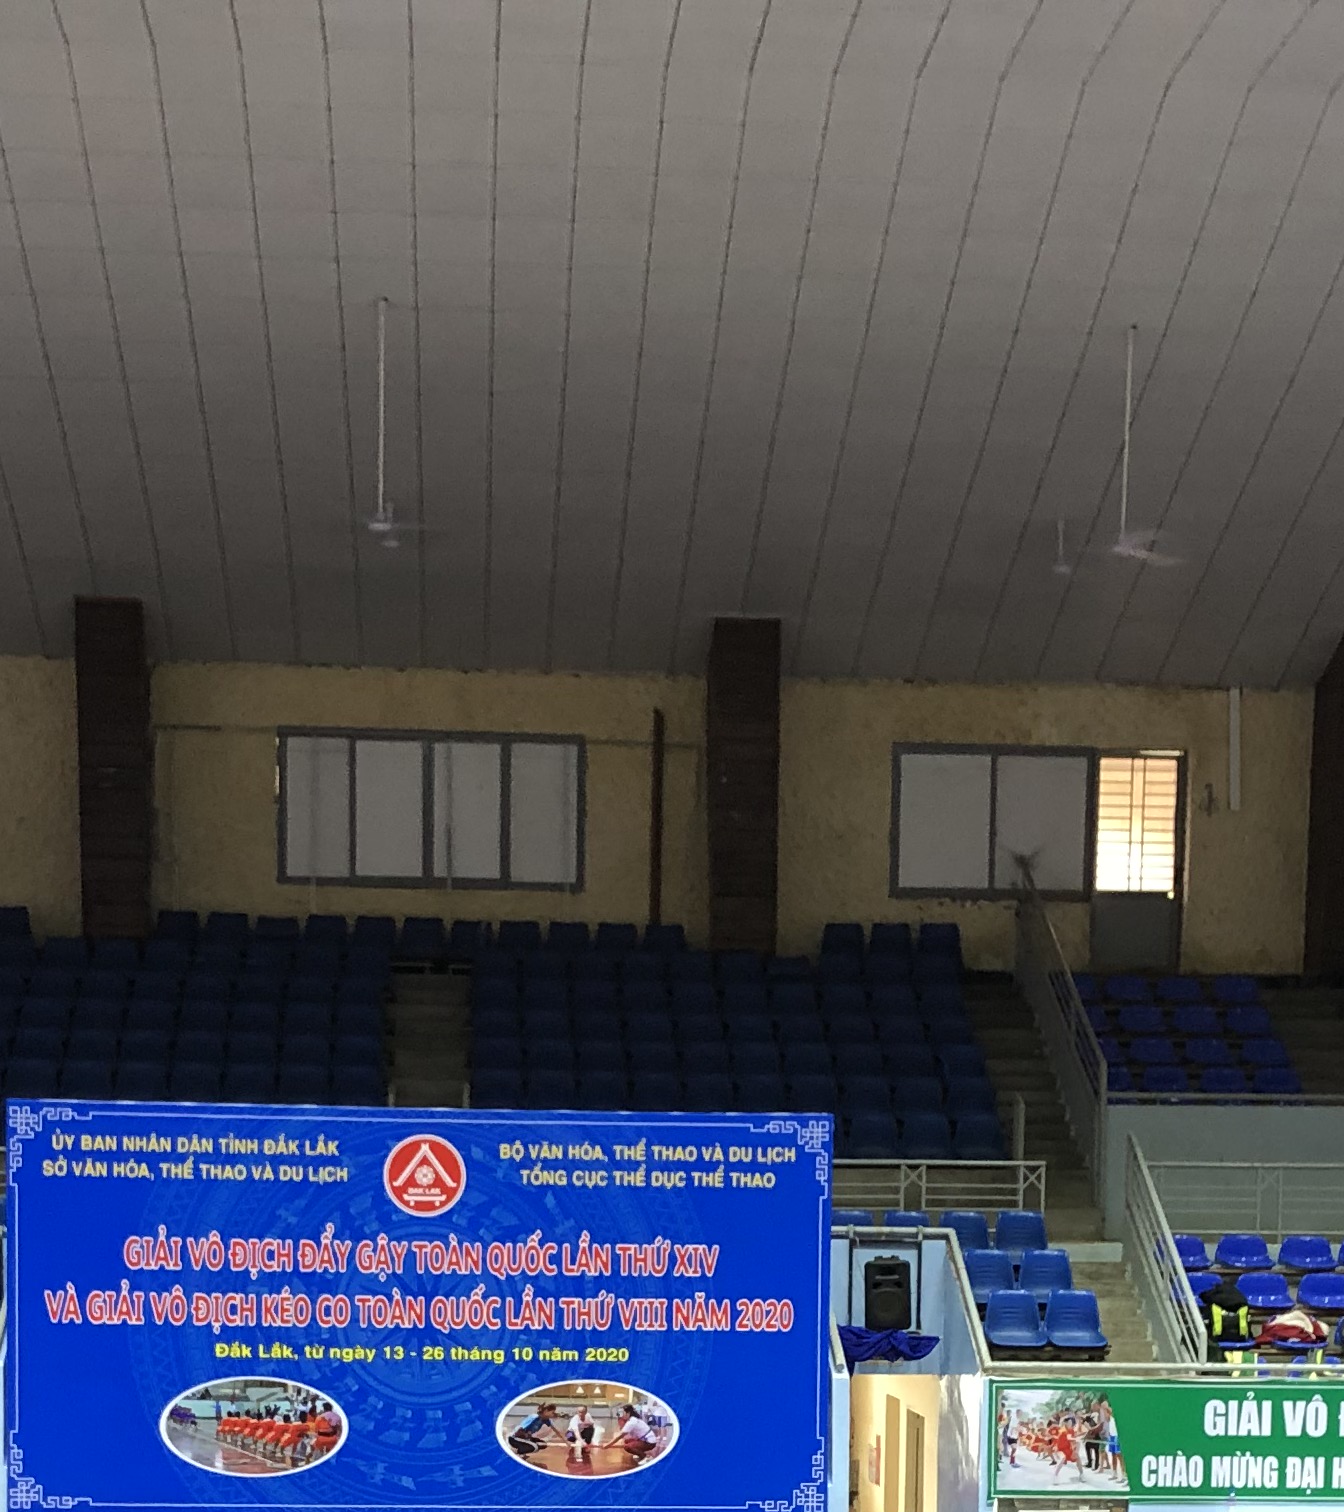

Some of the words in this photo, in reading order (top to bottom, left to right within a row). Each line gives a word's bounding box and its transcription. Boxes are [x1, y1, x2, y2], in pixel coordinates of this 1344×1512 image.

[52, 1129, 74, 1153] ỦY
[81, 1135, 117, 1153] BAN
[123, 1134, 171, 1154] NHÂN
[177, 1134, 212, 1155] DÂN
[219, 1133, 258, 1156] TỈNH
[264, 1134, 300, 1156] ĐẮK
[305, 1134, 339, 1156] LẮK
[499, 1140, 524, 1163] BỘ
[528, 1140, 562, 1160] VĂN
[568, 1139, 609, 1164] HÓA,
[613, 1138, 647, 1162] THỂ
[651, 1145, 698, 1163] THAO
[701, 1142, 725, 1163] VÀ
[728, 1146, 753, 1163] DU
[757, 1146, 797, 1166] LỊCH
[42, 1156, 68, 1176] SỞ
[72, 1158, 108, 1177] VĂN
[113, 1158, 155, 1180] HÓA,
[160, 1156, 196, 1180] THỂ
[199, 1164, 246, 1181] THAO
[252, 1160, 274, 1181] VÀ
[279, 1166, 302, 1182] DU
[308, 1166, 349, 1185] LỊCH
[520, 1162, 567, 1187] TỔNG
[572, 1170, 609, 1190] CỤC
[613, 1163, 647, 1188] THỂ
[651, 1171, 687, 1191] DỤC
[691, 1164, 725, 1189] THỂ
[729, 1171, 776, 1189] THAO
[123, 1224, 182, 1271] GIẢI
[186, 1230, 224, 1271] VÔ
[229, 1238, 293, 1280] ĐỊCH
[298, 1222, 352, 1273] ĐẨY
[357, 1233, 411, 1281] GẬY
[412, 1232, 482, 1276] TOÀN
[486, 1229, 557, 1279] QUỐC
[562, 1229, 612, 1277] LẦN
[617, 1234, 672, 1278] THỨ
[673, 1243, 719, 1277] XIV
[45, 1282, 81, 1325] VÀ
[86, 1278, 145, 1327] GIẢI
[149, 1285, 188, 1326] VÔ
[191, 1292, 256, 1335] ĐỊCH
[262, 1285, 311, 1328] KÉO
[316, 1294, 351, 1328] CO
[356, 1287, 425, 1330] TOÀN
[430, 1284, 501, 1334] QUỐC
[506, 1284, 555, 1331] LẦN
[559, 1290, 615, 1331] THỨ
[618, 1299, 667, 1331] VIII
[672, 1293, 731, 1331] NĂM
[736, 1299, 795, 1332] 2020
[214, 1342, 253, 1359] Đắk
[258, 1341, 299, 1361] Lắk,
[304, 1344, 325, 1359] từ
[330, 1345, 376, 1363] ngày
[384, 1346, 405, 1360] 13
[422, 1346, 444, 1361] 26
[450, 1345, 505, 1364] tháng
[512, 1347, 533, 1361] 10
[539, 1347, 579, 1361] năm
[585, 1347, 630, 1362] 2020
[1204, 1391, 1272, 1437] GIẢI
[1283, 1394, 1328, 1438] VÔ
[1141, 1450, 1204, 1487] CHÀO
[1210, 1451, 1279, 1488] MỪNG
[1285, 1457, 1325, 1495] ĐẠI
